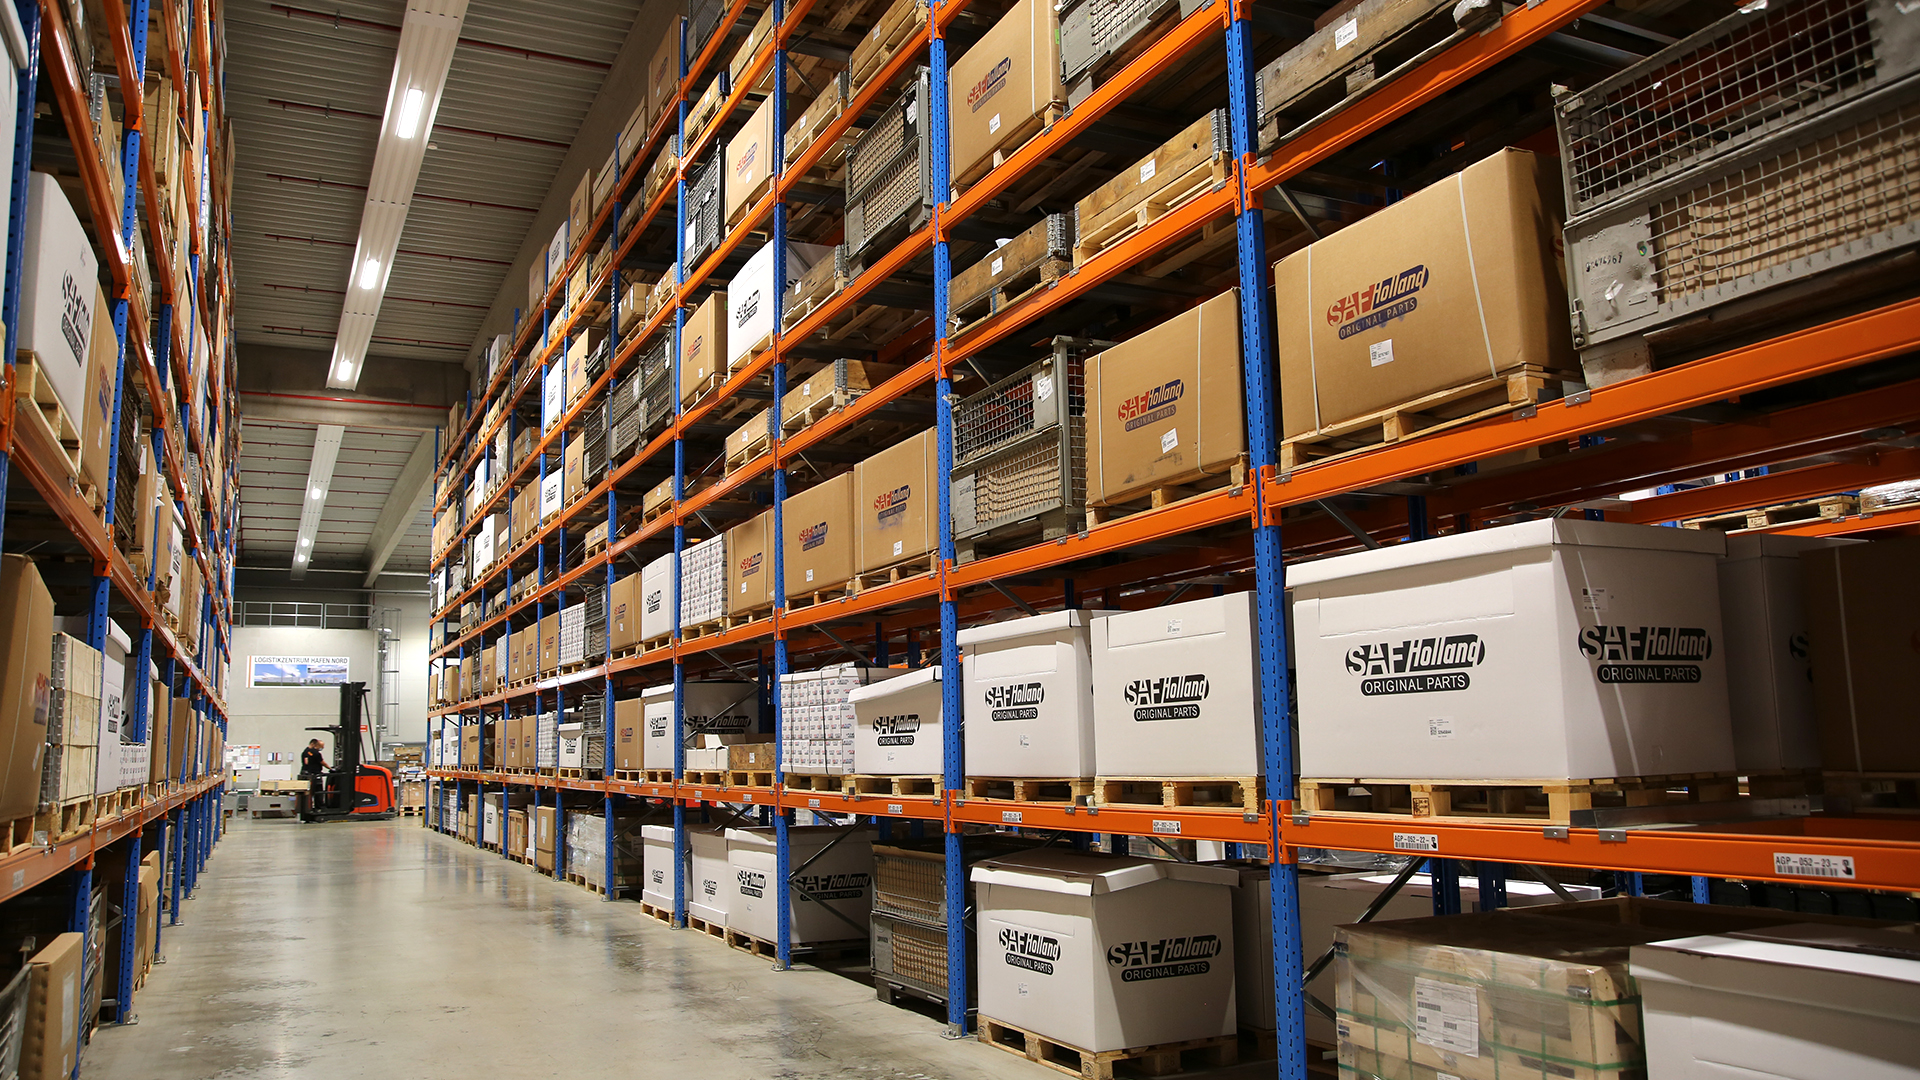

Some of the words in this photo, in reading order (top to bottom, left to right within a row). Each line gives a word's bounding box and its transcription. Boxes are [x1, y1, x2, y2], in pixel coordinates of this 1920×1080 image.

[1328, 288, 1371, 327] SAF
[1371, 265, 1426, 310] Holland
[1340, 314, 1381, 338] ORIGINAL
[1386, 299, 1415, 318] PARTS
[1118, 394, 1147, 421] SAF
[1147, 380, 1182, 410] Holland
[1126, 413, 1154, 431] ORIGINAL
[1156, 406, 1176, 420] PARTS
[874, 491, 891, 511] SAF
[1581, 625, 1641, 661] SAF
[1643, 626, 1709, 661] Holland
[1347, 642, 1404, 676] SAF
[1404, 635, 1482, 673] Holland
[1364, 678, 1423, 694] ORIGINAL
[1426, 675, 1466, 689] PARTS
[1601, 667, 1661, 681] ORIGINAL
[1664, 667, 1698, 681] PARTS
[985, 687, 1010, 708] SAF
[1011, 683, 1043, 706] Holland
[1125, 680, 1160, 705] SAF
[1161, 675, 1206, 703] Holland
[993, 711, 1018, 720] ORIGINAL
[1020, 709, 1037, 718] PARTS
[1135, 708, 1171, 720] ORIGINAL
[1173, 706, 1198, 718] PARTS
[874, 716, 896, 734] SAF
[828, 873, 870, 890] Holland
[839, 890, 861, 899] PARTS
[1000, 928, 1025, 954] SAF
[1025, 932, 1060, 961] Holland
[1109, 941, 1161, 968] SAF
[1161, 936, 1219, 962] Holland
[1006, 954, 1033, 970] ORIGINAL
[1033, 960, 1052, 974] PARTS
[1125, 967, 1175, 981] ORIGINAL
[1177, 962, 1208, 975] PARTS
